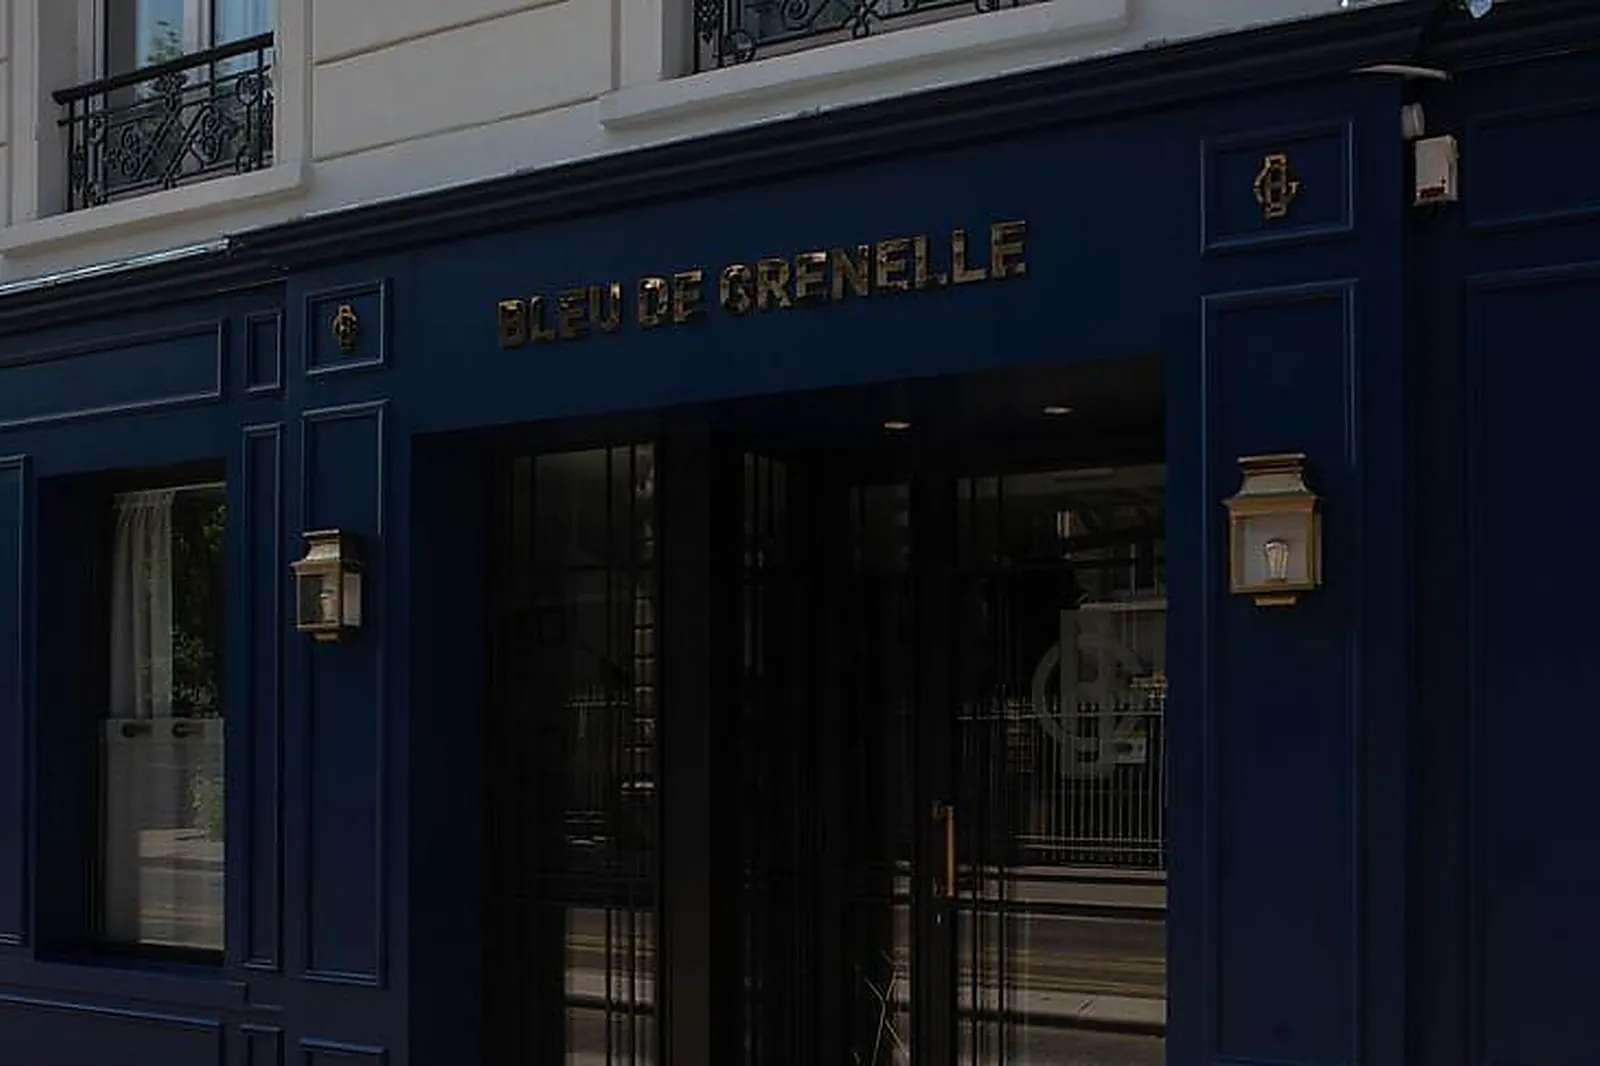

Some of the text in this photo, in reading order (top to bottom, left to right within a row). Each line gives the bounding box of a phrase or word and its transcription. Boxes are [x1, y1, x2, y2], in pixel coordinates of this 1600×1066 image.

[497, 219, 1028, 350] BLEU DE GRENELLE
